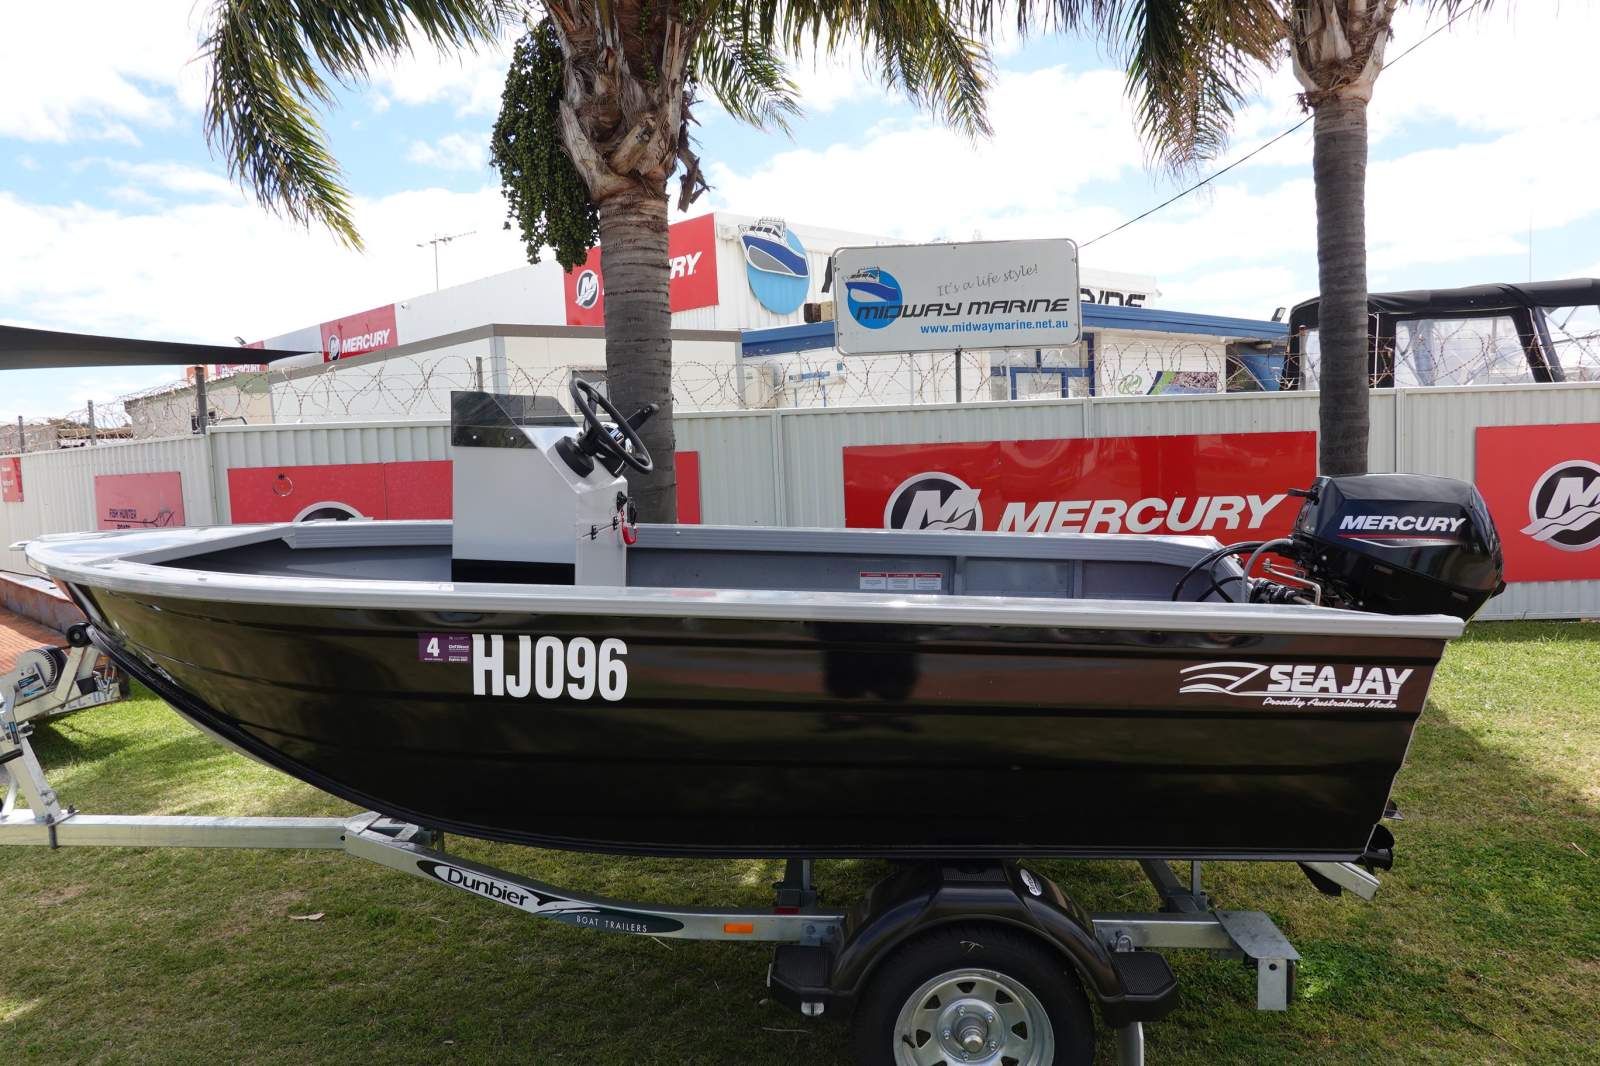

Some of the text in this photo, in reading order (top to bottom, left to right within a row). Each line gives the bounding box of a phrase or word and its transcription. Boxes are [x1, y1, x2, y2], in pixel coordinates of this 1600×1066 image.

[937, 264, 1039, 297] It's a life style!
[856, 299, 1070, 321] MIDWAY MARINE
[920, 320, 1069, 334] www.midwaymarine.net.au
[342, 329, 390, 354] MERCURY
[998, 494, 1289, 533] MERCURY
[1339, 515, 1466, 532] MERCURY
[426, 637, 440, 657] 4
[472, 634, 628, 702] HJ096
[1267, 665, 1414, 695] SEA JAY
[1262, 697, 1397, 709] Proudly Australian Made
[447, 867, 528, 906] Dunbier
[576, 915, 647, 933] BOAT TRAILERS
